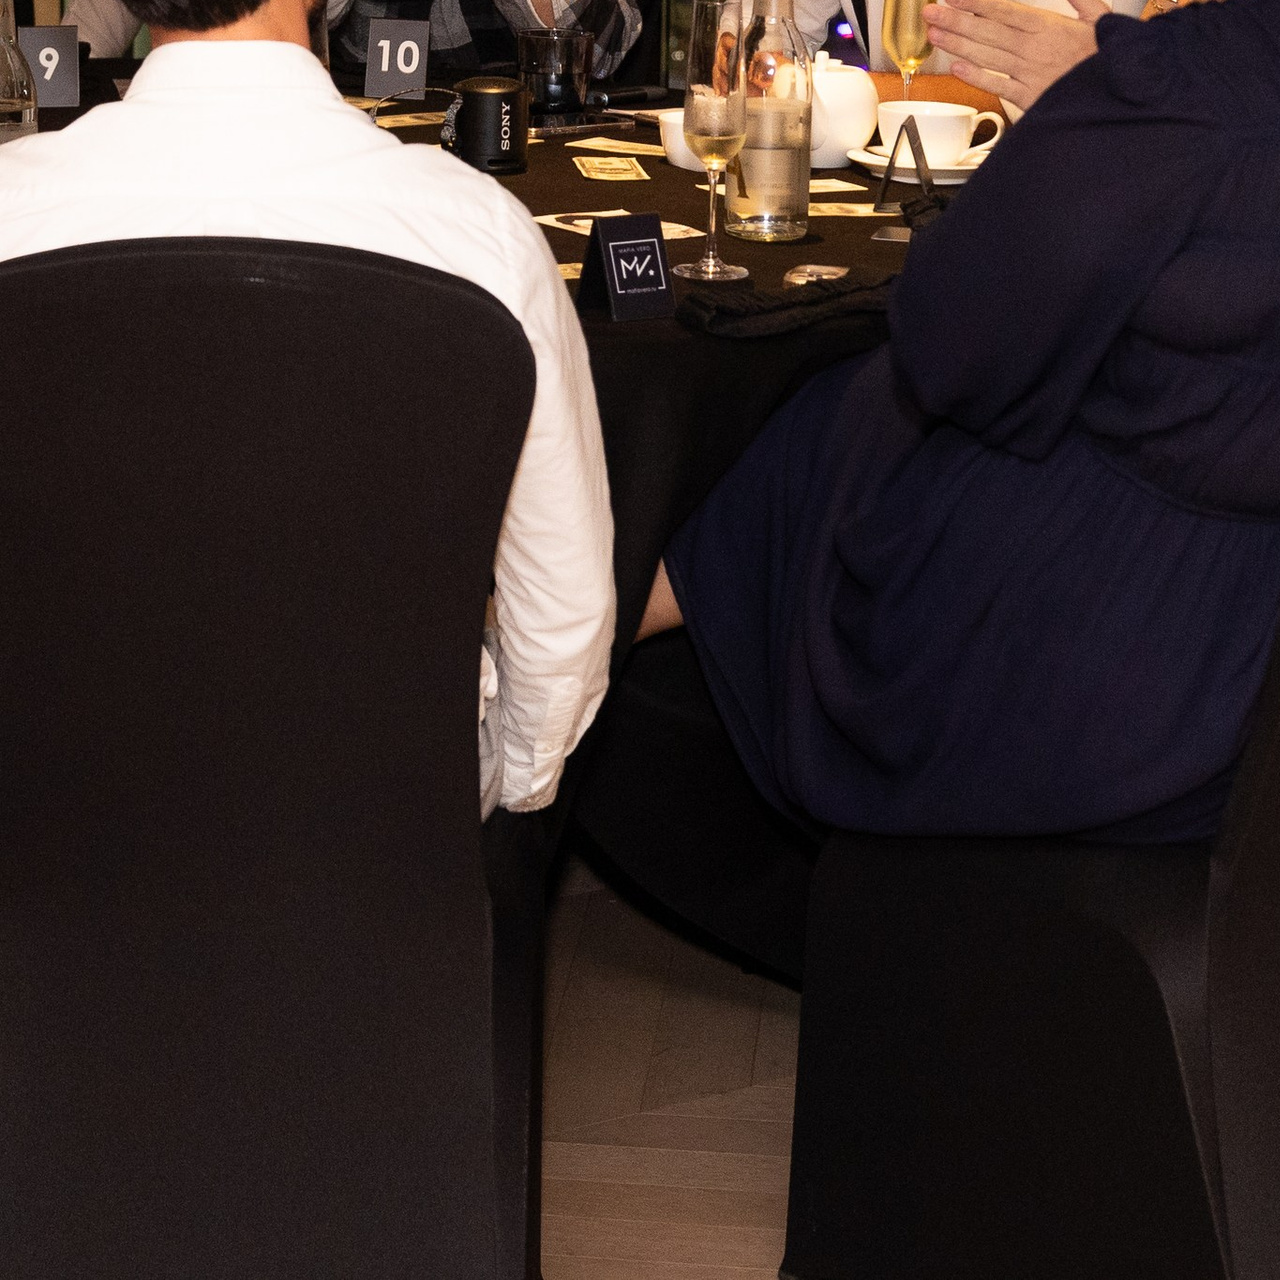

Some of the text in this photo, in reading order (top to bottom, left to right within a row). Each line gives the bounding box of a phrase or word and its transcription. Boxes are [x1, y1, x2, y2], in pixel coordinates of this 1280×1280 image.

[38, 47, 60, 81] 9
[377, 39, 420, 74] 10
[501, 101, 510, 150] SONY
